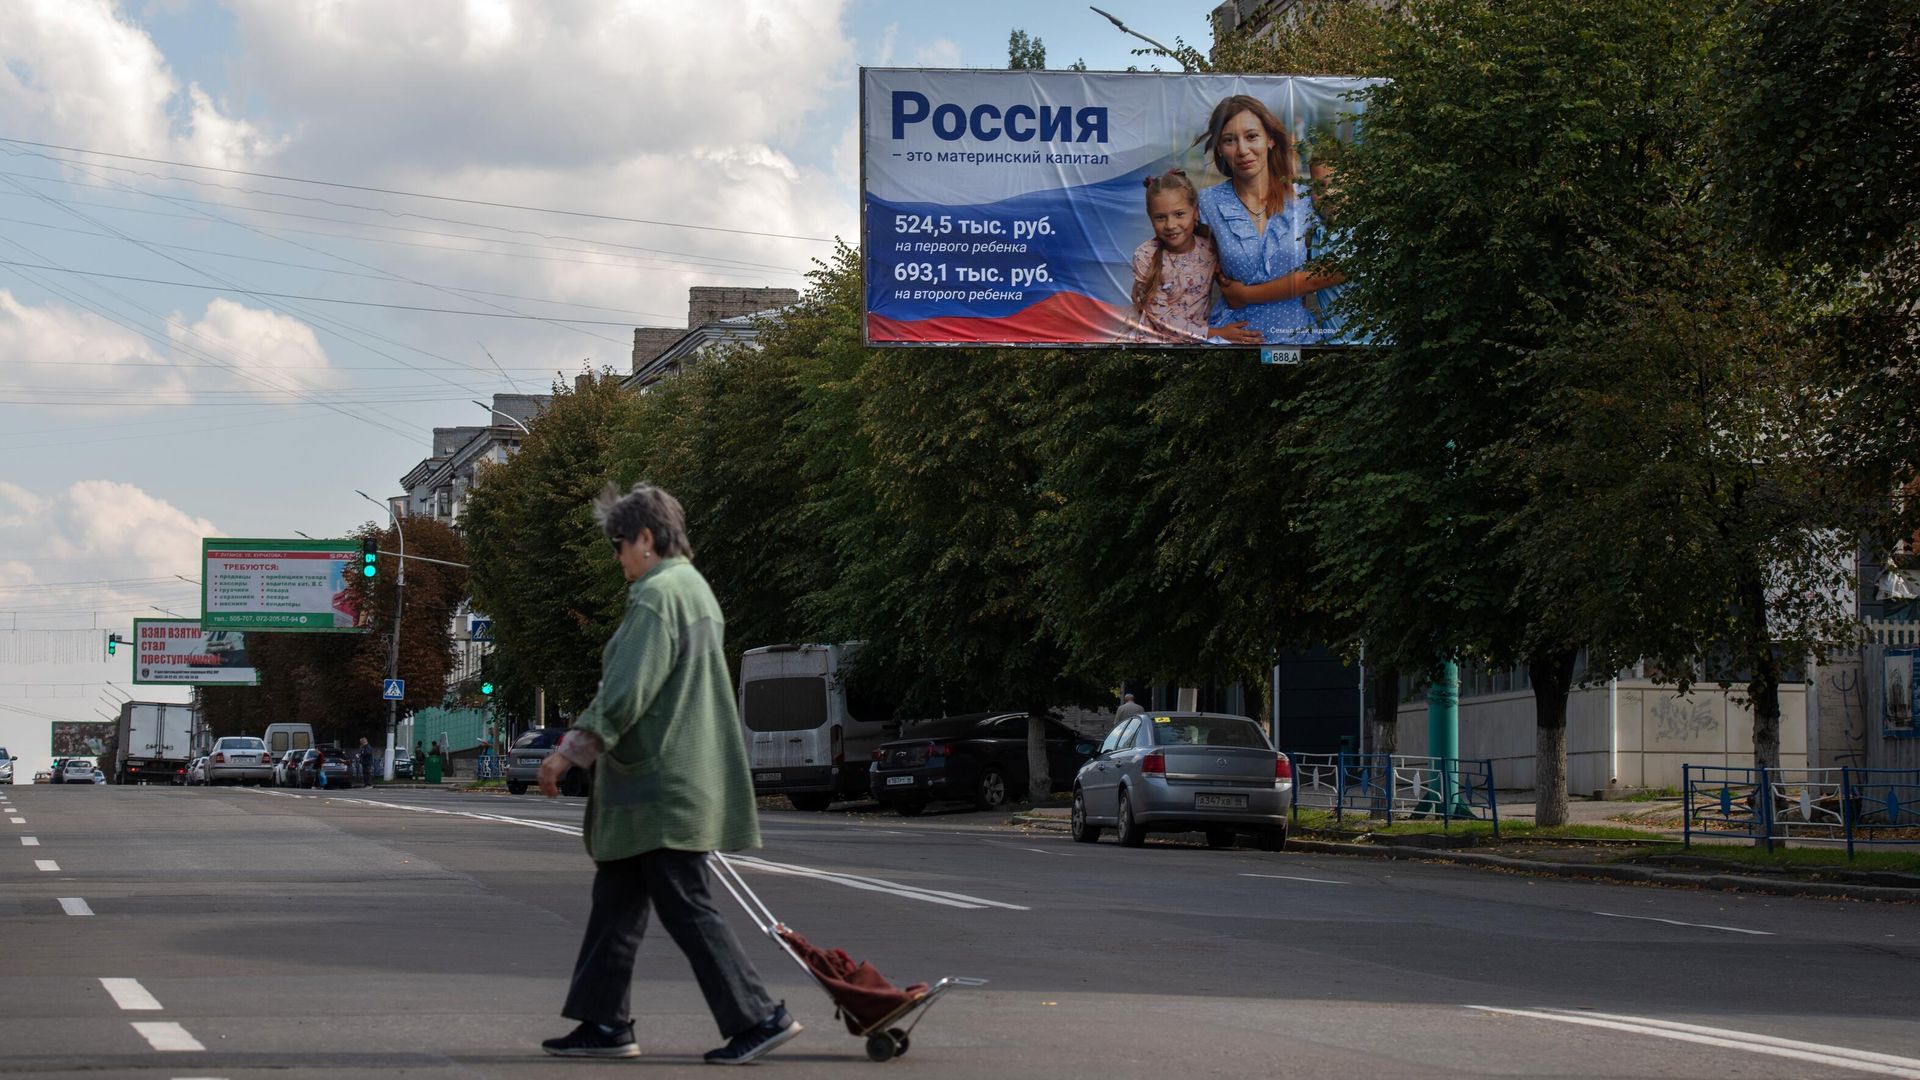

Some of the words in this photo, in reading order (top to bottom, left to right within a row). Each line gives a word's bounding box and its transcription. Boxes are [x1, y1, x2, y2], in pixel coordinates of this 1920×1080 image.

[891, 91, 1109, 143] Россия
[907, 151, 933, 162] это
[937, 150, 1041, 165] материнский
[1045, 152, 1109, 165] капитал
[895, 215, 952, 237] 524,5
[958, 219, 1007, 235] тыс.
[1013, 216, 1056, 239] руб.
[895, 241, 912, 252] на
[915, 242, 970, 254] первого
[972, 241, 1027, 255] ребенка
[894, 262, 947, 285] 693,1
[955, 267, 1004, 282] тыс.
[1011, 263, 1054, 287] руб.
[894, 289, 911, 300] на
[914, 290, 966, 302] второго
[968, 288, 1023, 302] ребенка
[1273, 352, 1290, 362] 688
[365, 554, 376, 563] 04
[223, 563, 279, 571] ТРЕБУЮТСЯ:
[141, 627, 166, 639] ВЗЯЛ
[168, 627, 202, 639] ВЗЯТКУ
[141, 641, 166, 651] стал
